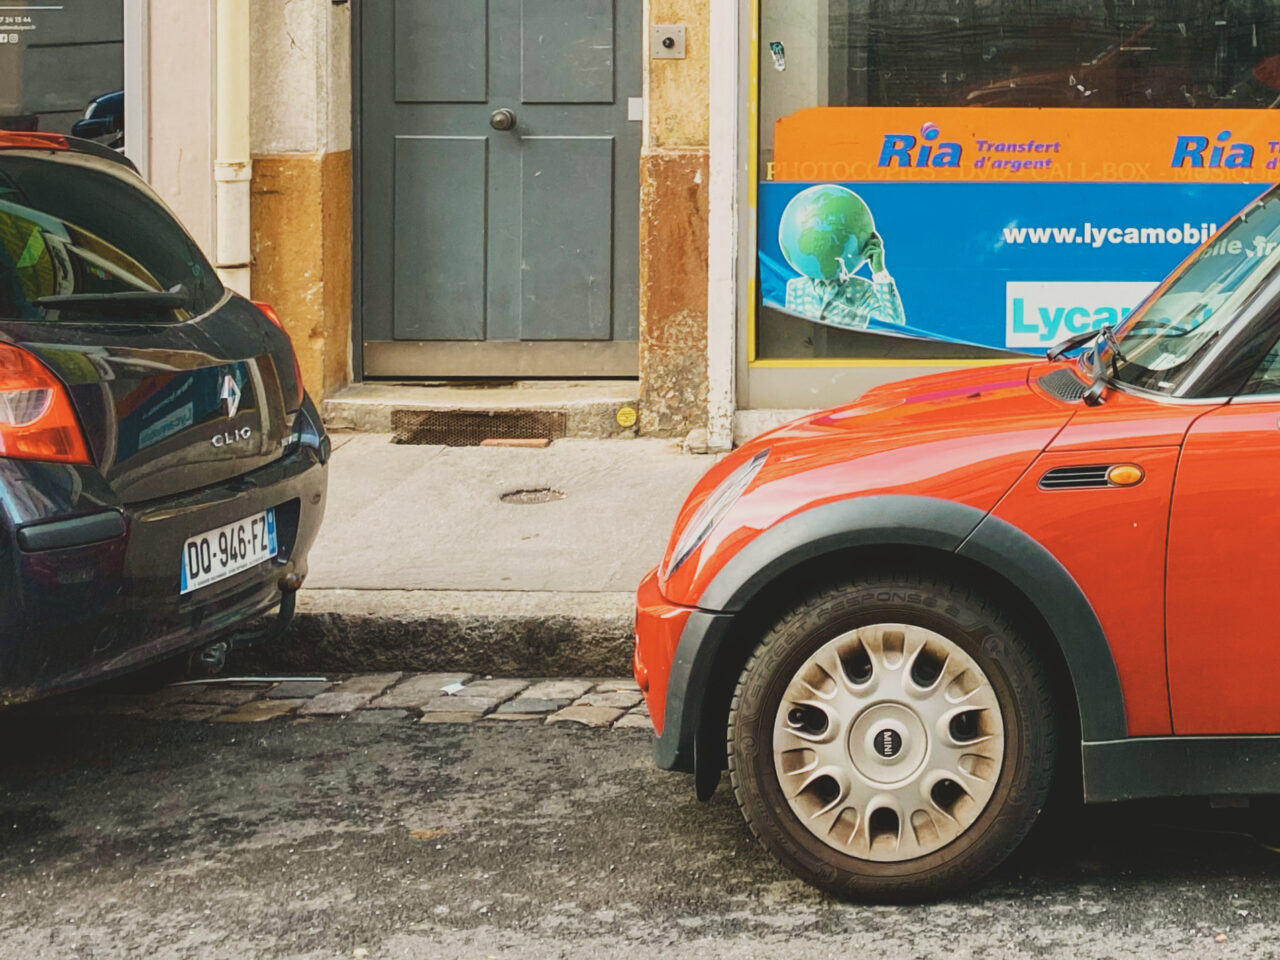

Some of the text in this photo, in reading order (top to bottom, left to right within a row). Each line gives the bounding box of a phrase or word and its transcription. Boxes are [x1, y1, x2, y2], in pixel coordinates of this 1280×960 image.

[877, 122, 963, 169] Ria
[975, 139, 1061, 153] Transfert
[1170, 130, 1256, 169] Ria
[973, 155, 1053, 173] d'argent
[211, 426, 252, 448] CLIO
[187, 515, 268, 580] DQ-946-FZ
[883, 731, 893, 755] MINI
